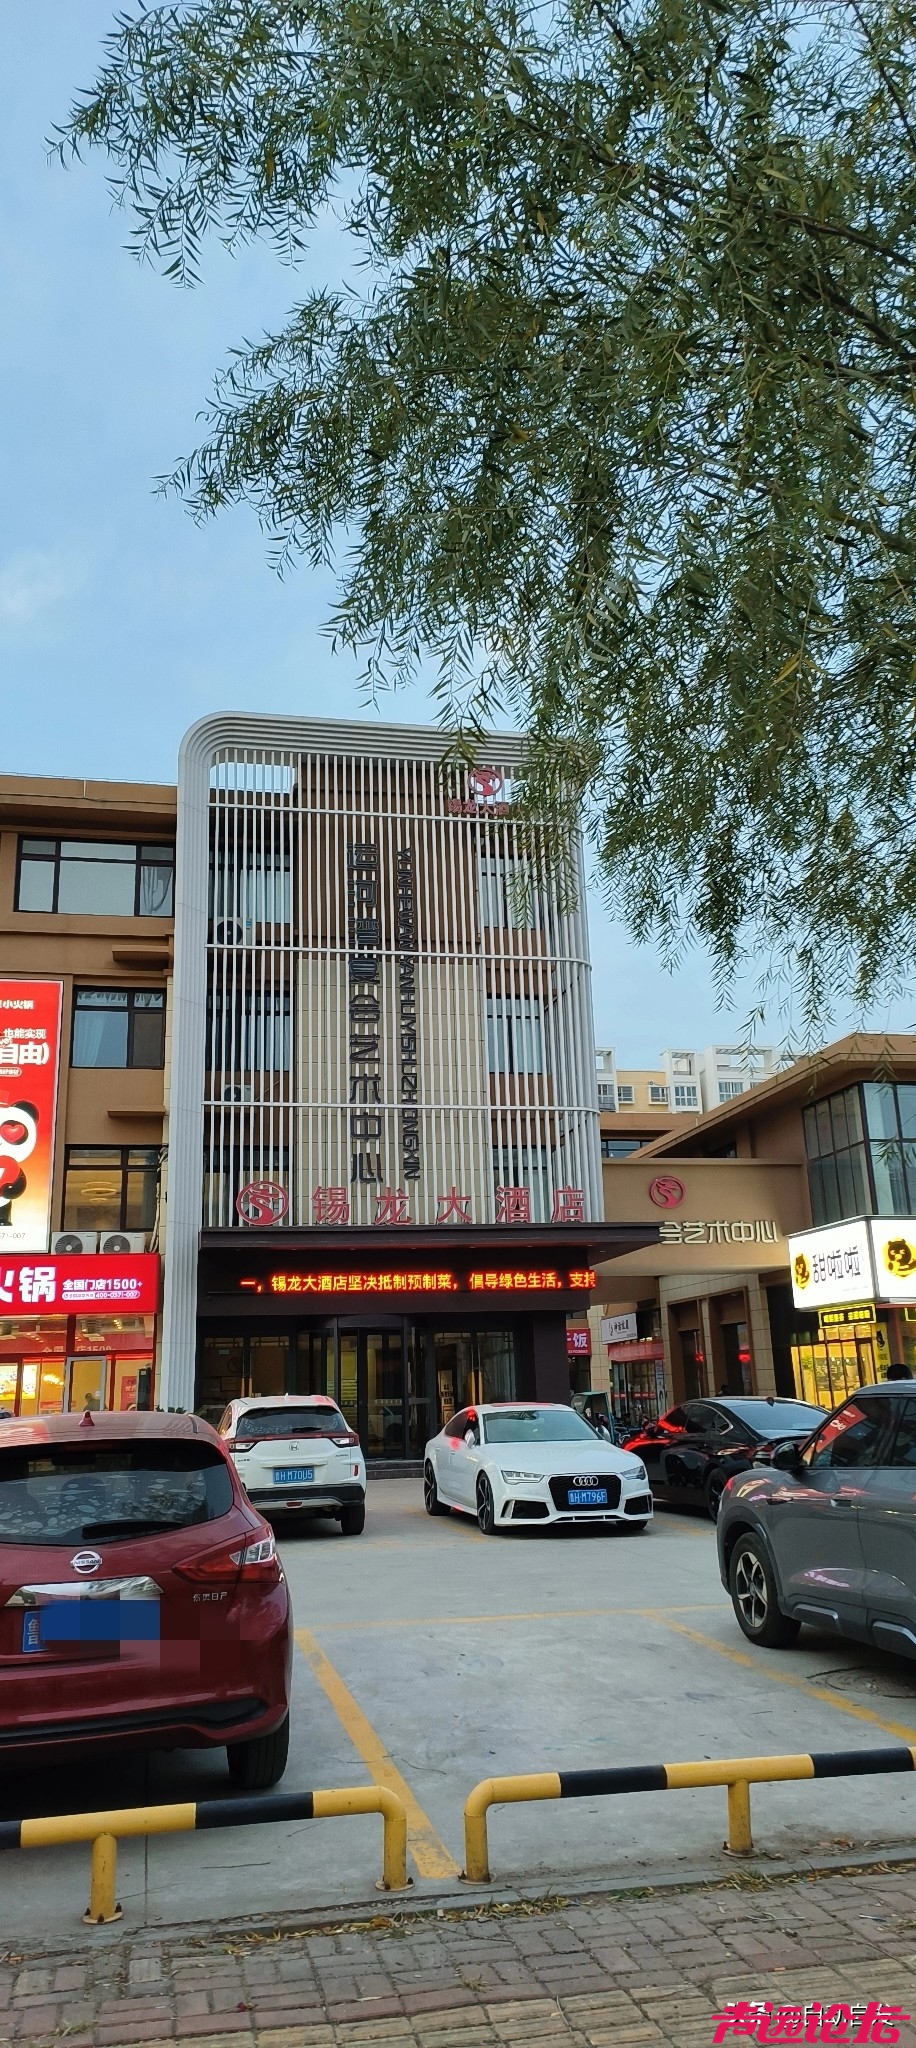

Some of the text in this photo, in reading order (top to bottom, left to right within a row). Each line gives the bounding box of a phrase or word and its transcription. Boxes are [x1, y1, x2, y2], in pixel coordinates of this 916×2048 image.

[448, 798, 511, 816] 锡龙大酒
[0, 999, 35, 1009] 小火锅
[3, 1028, 47, 1039] 也能实现
[311, 1185, 585, 1225] 锡龙大酒店
[812, 1245, 861, 1283] 甜啦啦
[73, 1558, 101, 1566] NISSAN
